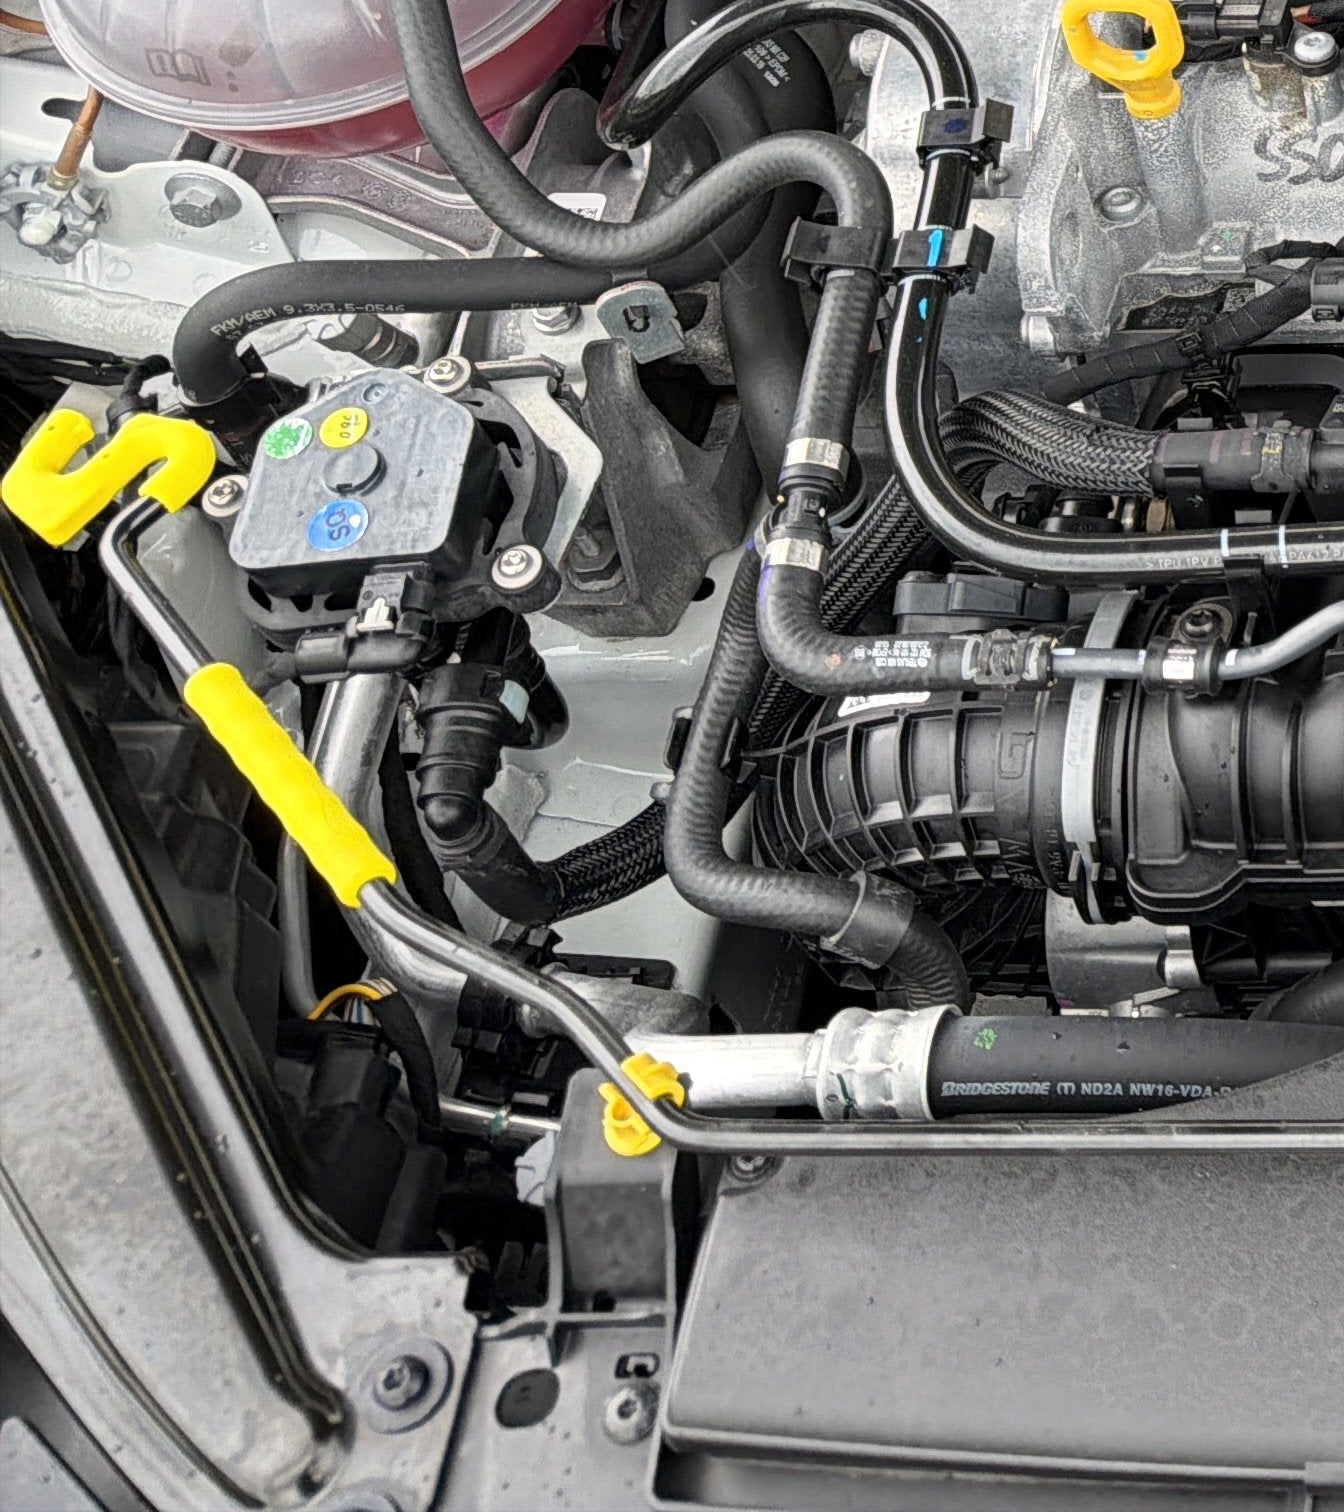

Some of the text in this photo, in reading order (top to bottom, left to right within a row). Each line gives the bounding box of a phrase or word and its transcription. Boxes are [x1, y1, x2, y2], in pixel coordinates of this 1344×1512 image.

[941, 1081, 1050, 1096] BRIDGESTONE
[1056, 1082, 1076, 1095] (T)
[1080, 1082, 1124, 1096] ND2A
